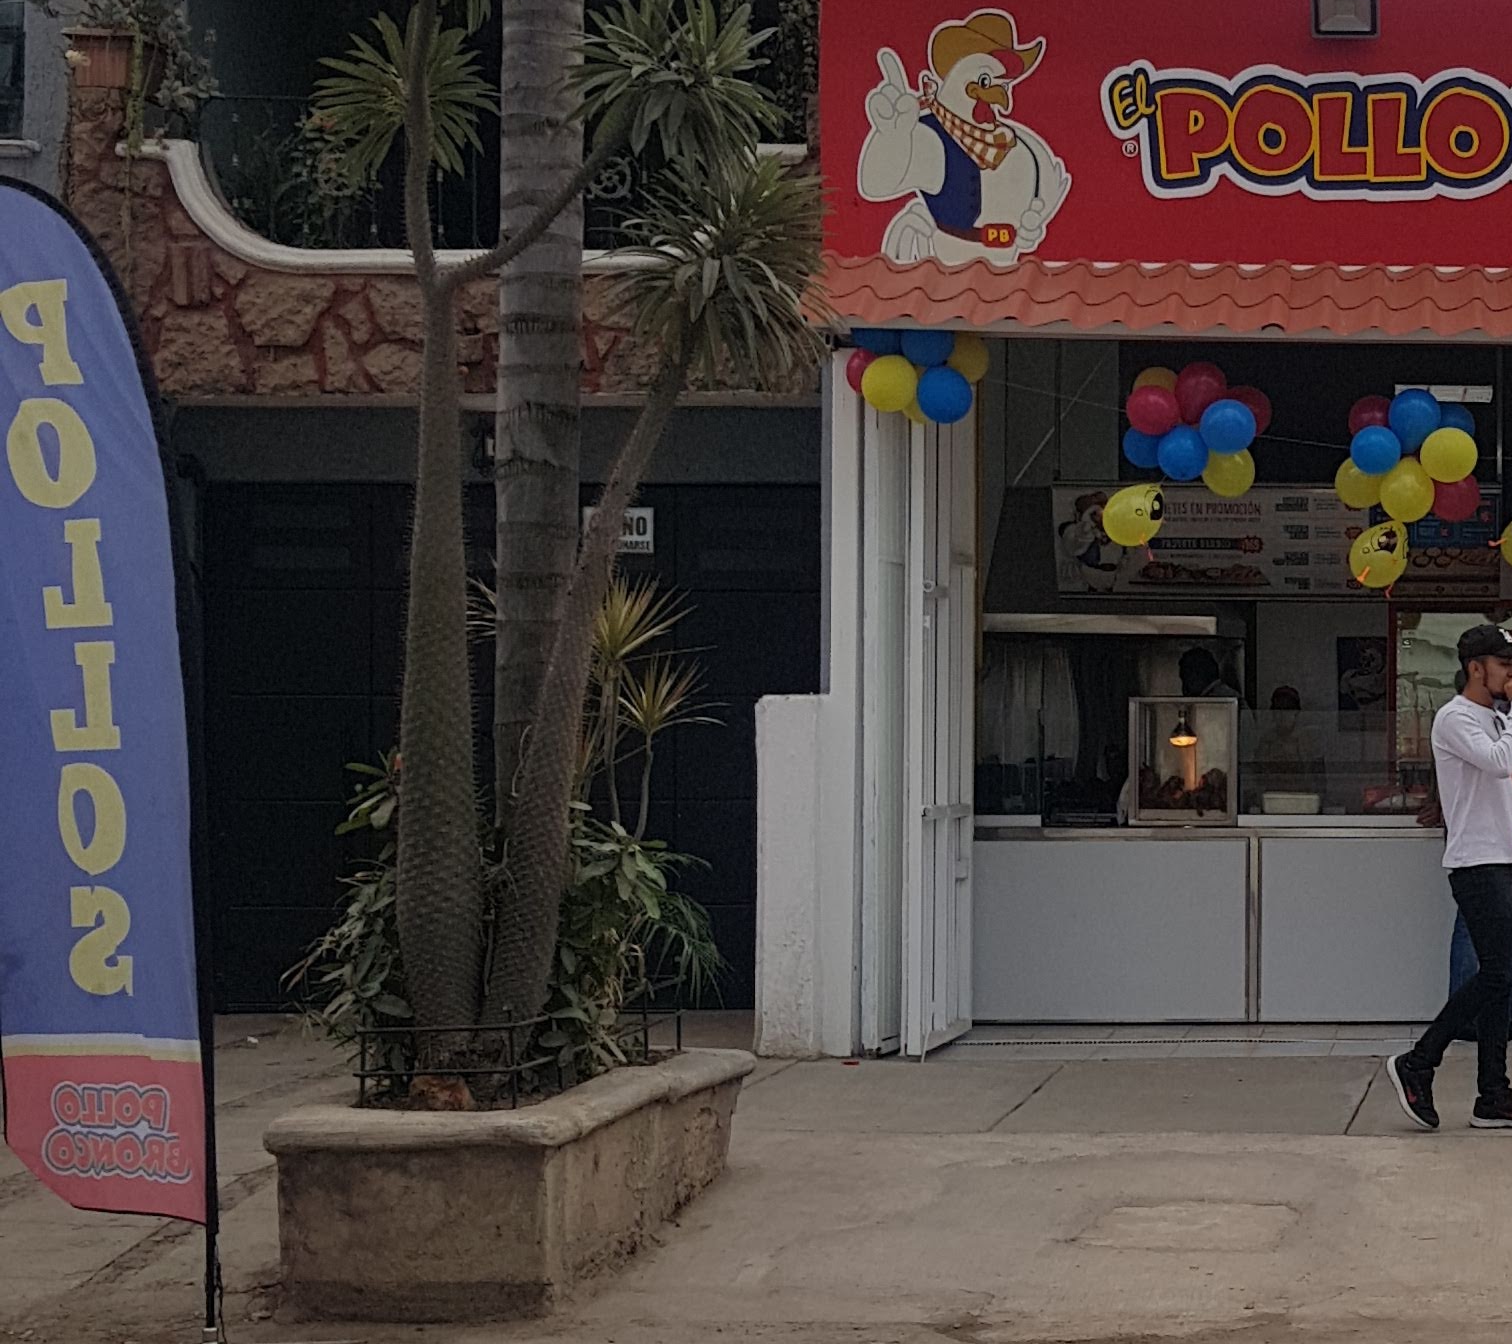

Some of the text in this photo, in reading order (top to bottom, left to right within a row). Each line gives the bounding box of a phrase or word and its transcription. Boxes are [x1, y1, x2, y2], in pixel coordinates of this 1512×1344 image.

[1109, 69, 1157, 129] El
[1149, 79, 1512, 186] POLLO
[987, 228, 1010, 243] PB
[622, 516, 648, 536] NO
